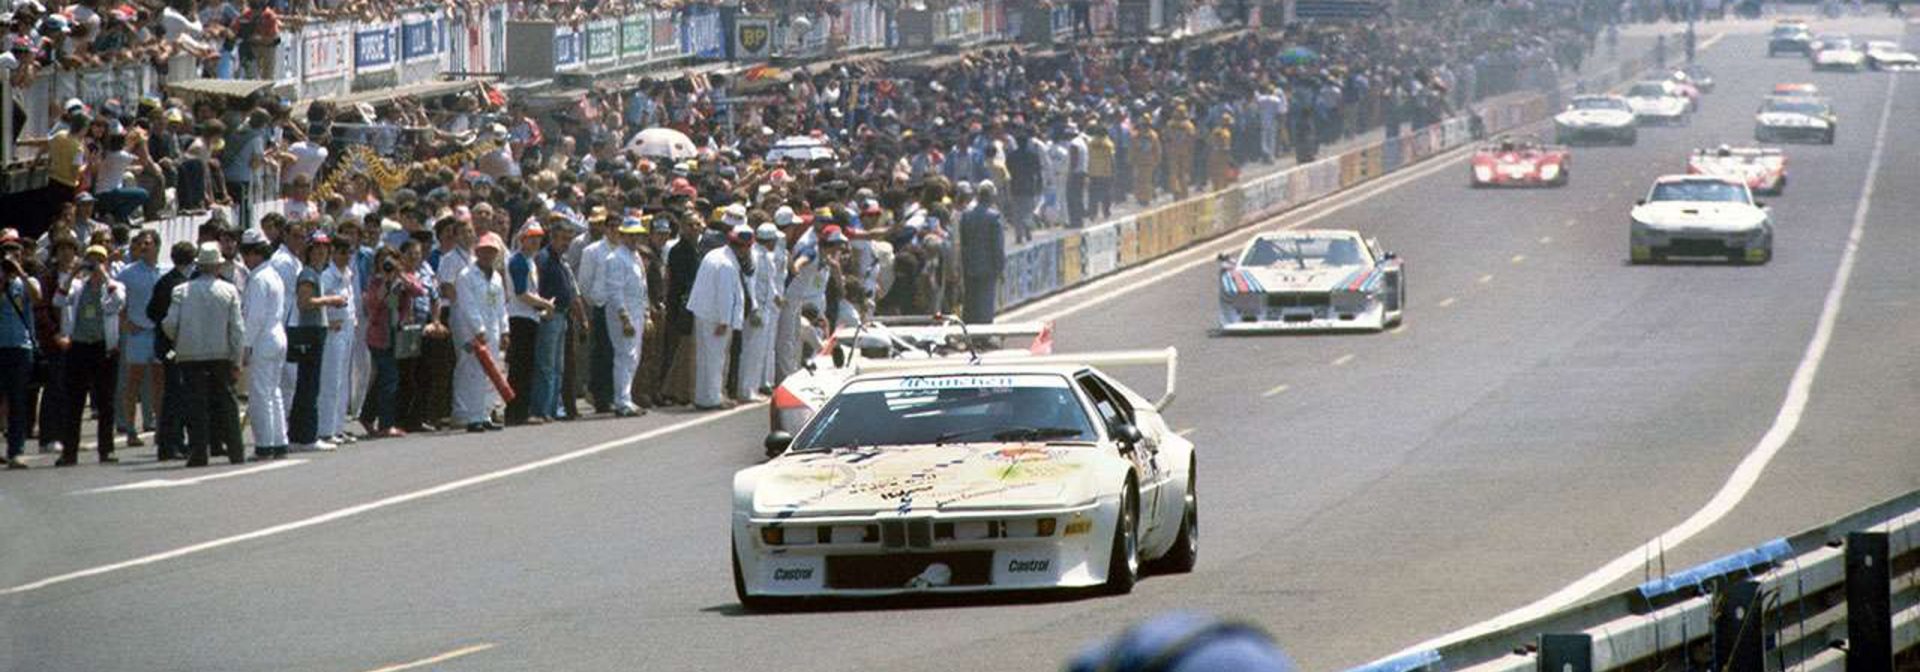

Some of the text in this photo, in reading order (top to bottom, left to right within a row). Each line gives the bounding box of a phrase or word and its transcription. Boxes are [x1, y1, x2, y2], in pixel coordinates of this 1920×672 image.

[743, 28, 766, 48] BP
[1008, 559, 1051, 572] Castrol
[773, 567, 815, 581] Castrol
